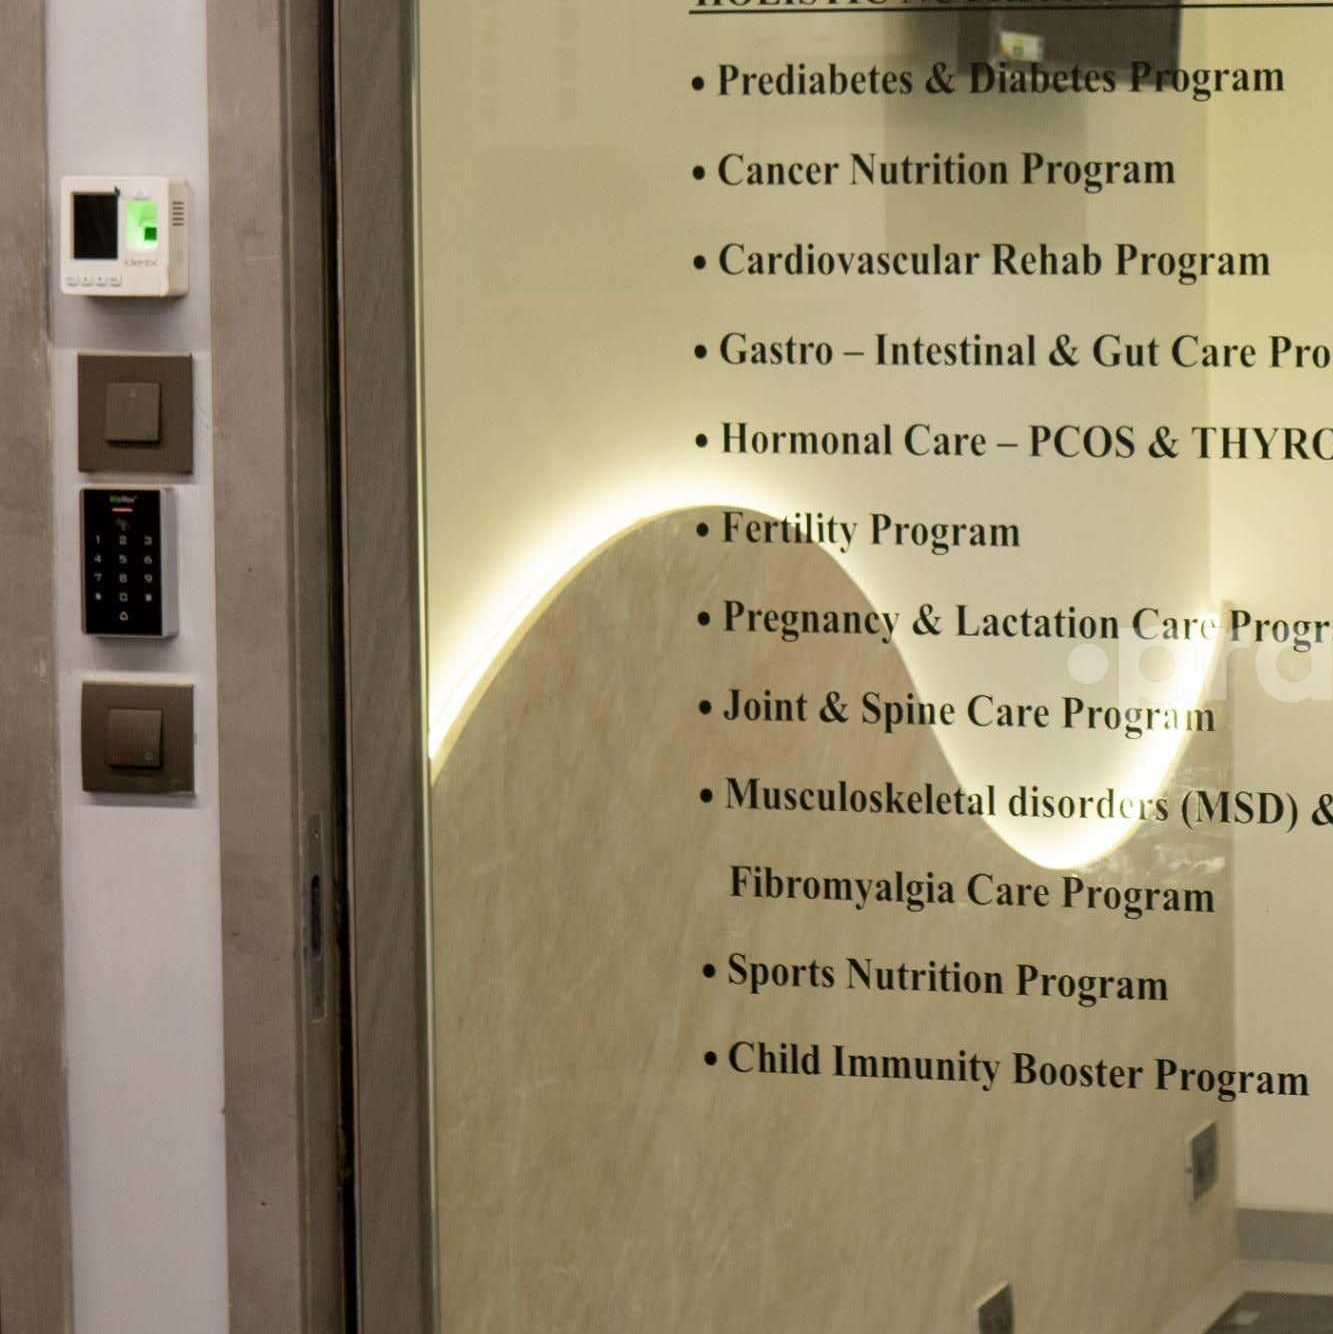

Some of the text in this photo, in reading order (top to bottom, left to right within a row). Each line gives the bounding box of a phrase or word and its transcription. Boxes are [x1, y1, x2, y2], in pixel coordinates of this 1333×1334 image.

[718, 60, 1285, 102] Prediabetes & Diabetes Program
[718, 151, 1176, 194] Cancer Nutrition Program
[718, 243, 1270, 285] Cardiovascular Rehab Program
[719, 332, 833, 366] Gastro
[875, 333, 1036, 367] Intestinal
[1049, 335, 1079, 367] &
[1092, 335, 1159, 368] Gut
[1172, 336, 1256, 368] Care
[721, 422, 892, 456] Hormonal
[904, 424, 987, 457] Care
[1028, 425, 1136, 458] PCOS
[1149, 426, 1179, 459] &
[722, 511, 1021, 555] Fertility Program
[722, 600, 900, 644] Pregnancy
[912, 604, 943, 636] &
[955, 604, 1120, 639] Lactation
[1132, 607, 1216, 641] Care
[722, 689, 1216, 739] Joint & Spine Care Program
[725, 778, 997, 818] Musculoskeletal
[1008, 785, 1170, 822] disorders
[1181, 789, 1298, 833] (MSD)
[729, 865, 1216, 919] Fibromyalgia Care Program
[727, 953, 1169, 1006] Sports Nutrition Program
[728, 1041, 1311, 1102] Child Immunity Booster Program
